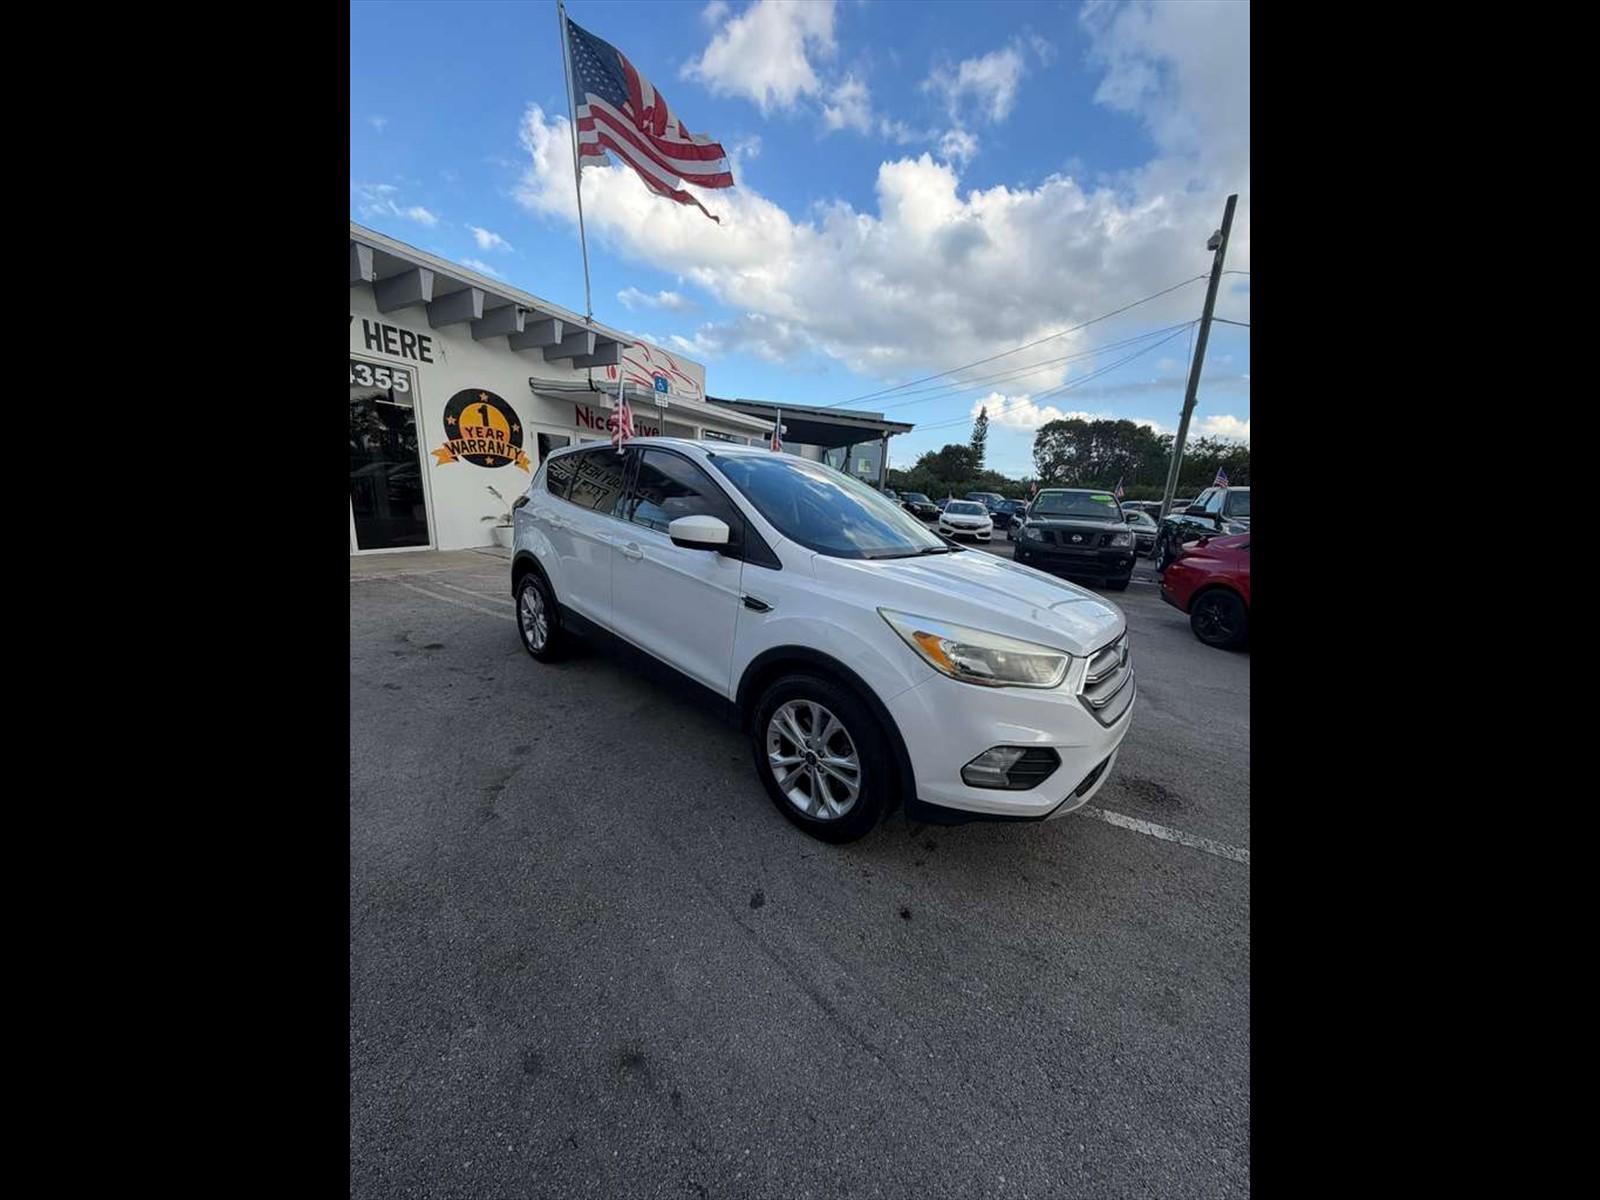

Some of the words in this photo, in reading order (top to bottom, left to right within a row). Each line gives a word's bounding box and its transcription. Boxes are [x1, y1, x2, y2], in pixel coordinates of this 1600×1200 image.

[362, 318, 434, 364] HERE
[350, 364, 410, 393] 355
[477, 404, 490, 427] 1
[465, 426, 505, 441] YEAR
[444, 439, 525, 461] WARRANTY
